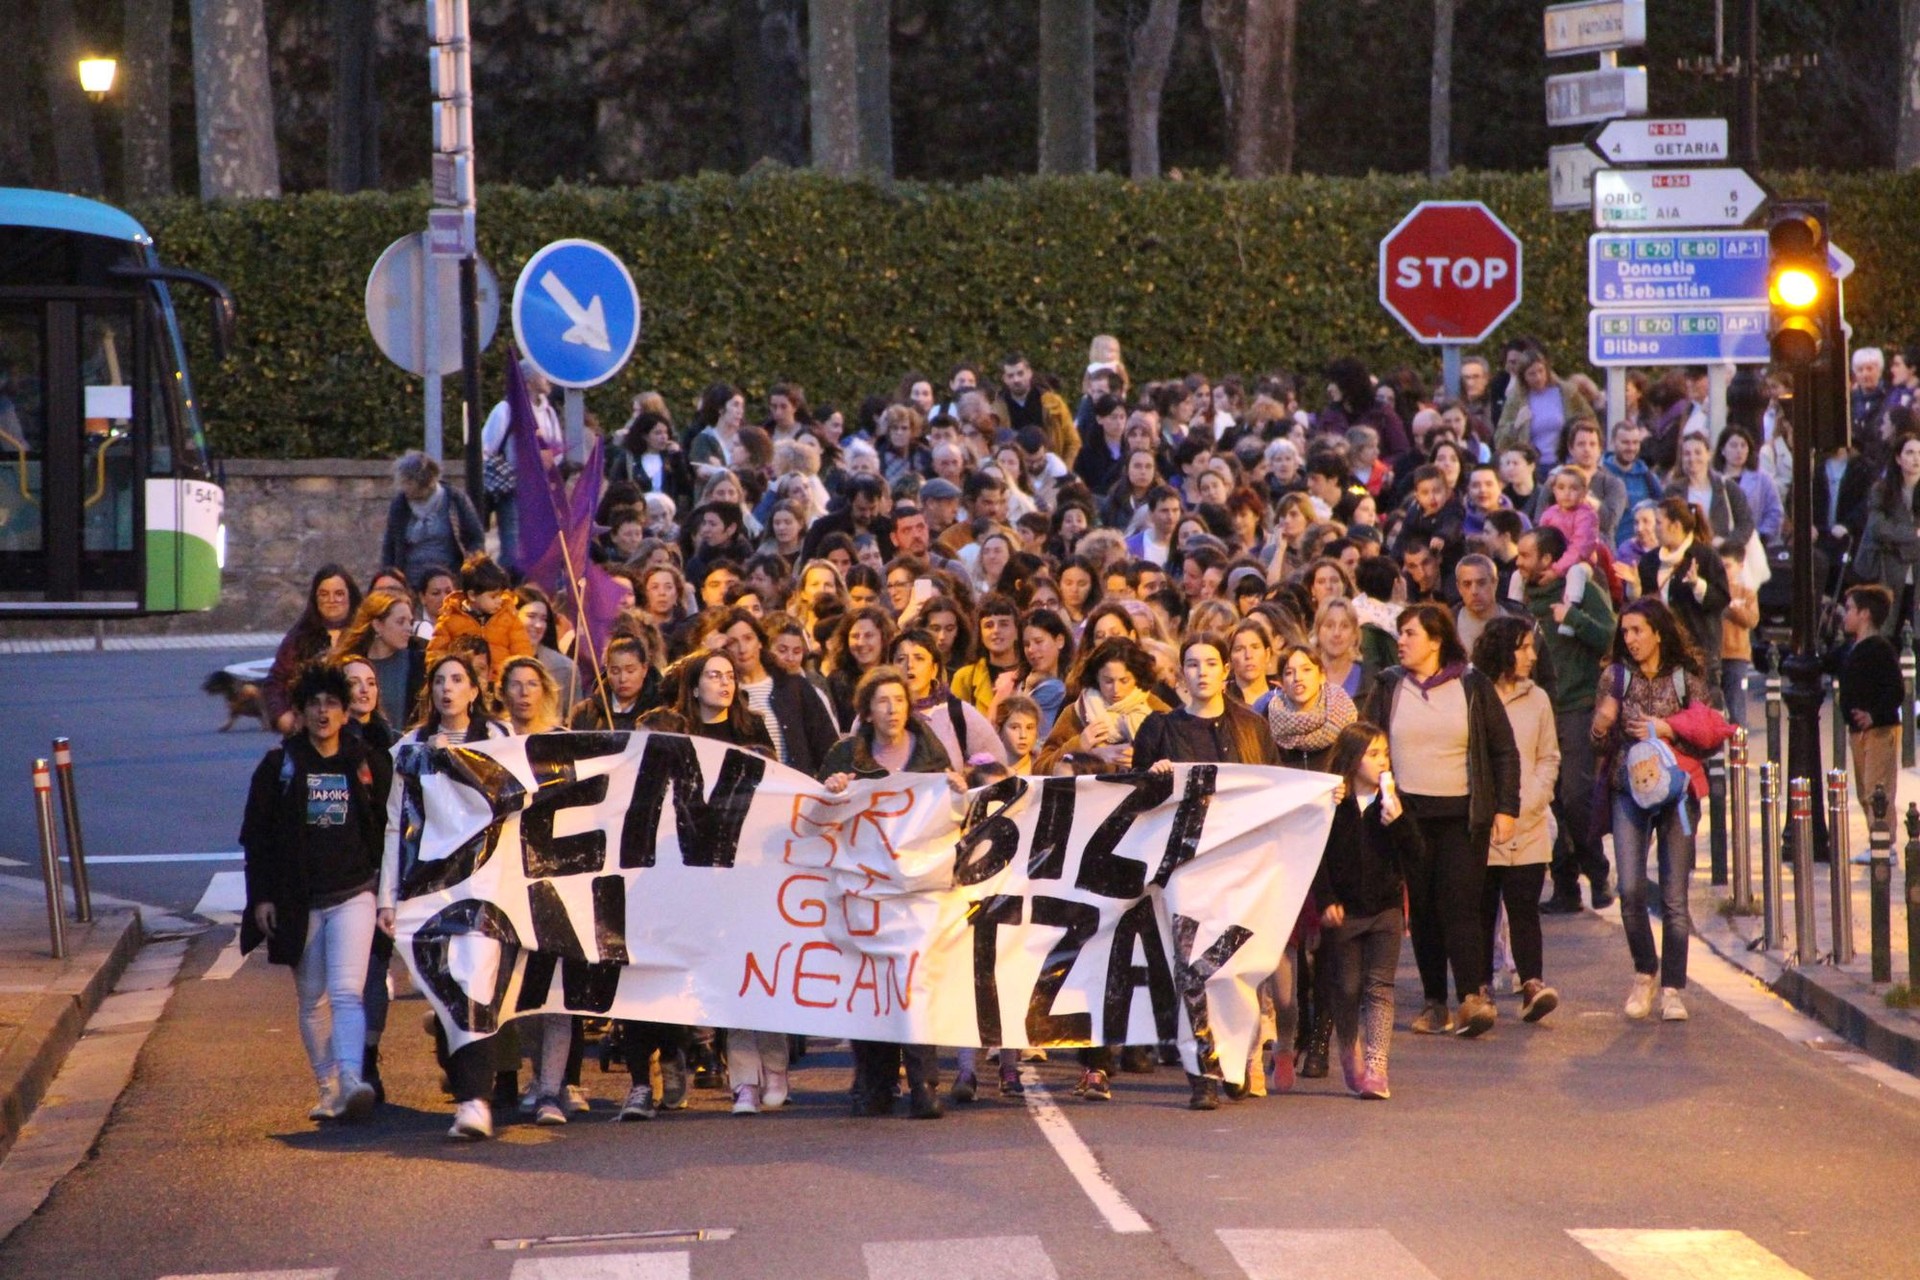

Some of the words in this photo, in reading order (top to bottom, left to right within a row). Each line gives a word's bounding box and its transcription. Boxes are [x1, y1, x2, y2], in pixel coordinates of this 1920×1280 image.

[1612, 143, 1621, 154] 4
[1654, 142, 1720, 155] GETARIA
[1604, 192, 1642, 204] ORIO
[1656, 207, 1680, 219] AIA
[1724, 206, 1738, 218] 12
[1603, 243, 1628, 256] E-5
[1638, 243, 1671, 256] E-70
[1681, 242, 1716, 255] E-80
[1727, 241, 1759, 254] AP-1
[1396, 256, 1508, 289] STOP
[1618, 261, 1696, 276] Donostia
[1603, 320, 1628, 333] E-5
[1638, 319, 1671, 332] E-70
[1681, 318, 1717, 332] E-80
[1727, 318, 1759, 331] AP-1
[1603, 339, 1660, 355] Bilbao
[396, 731, 766, 901] DEN
[790, 788, 914, 860] ER
[953, 764, 1218, 898] BIZI
[777, 874, 880, 936] GU
[412, 874, 630, 1033] ON
[738, 940, 919, 1016] NEAN
[968, 894, 1254, 1079] TZAK
